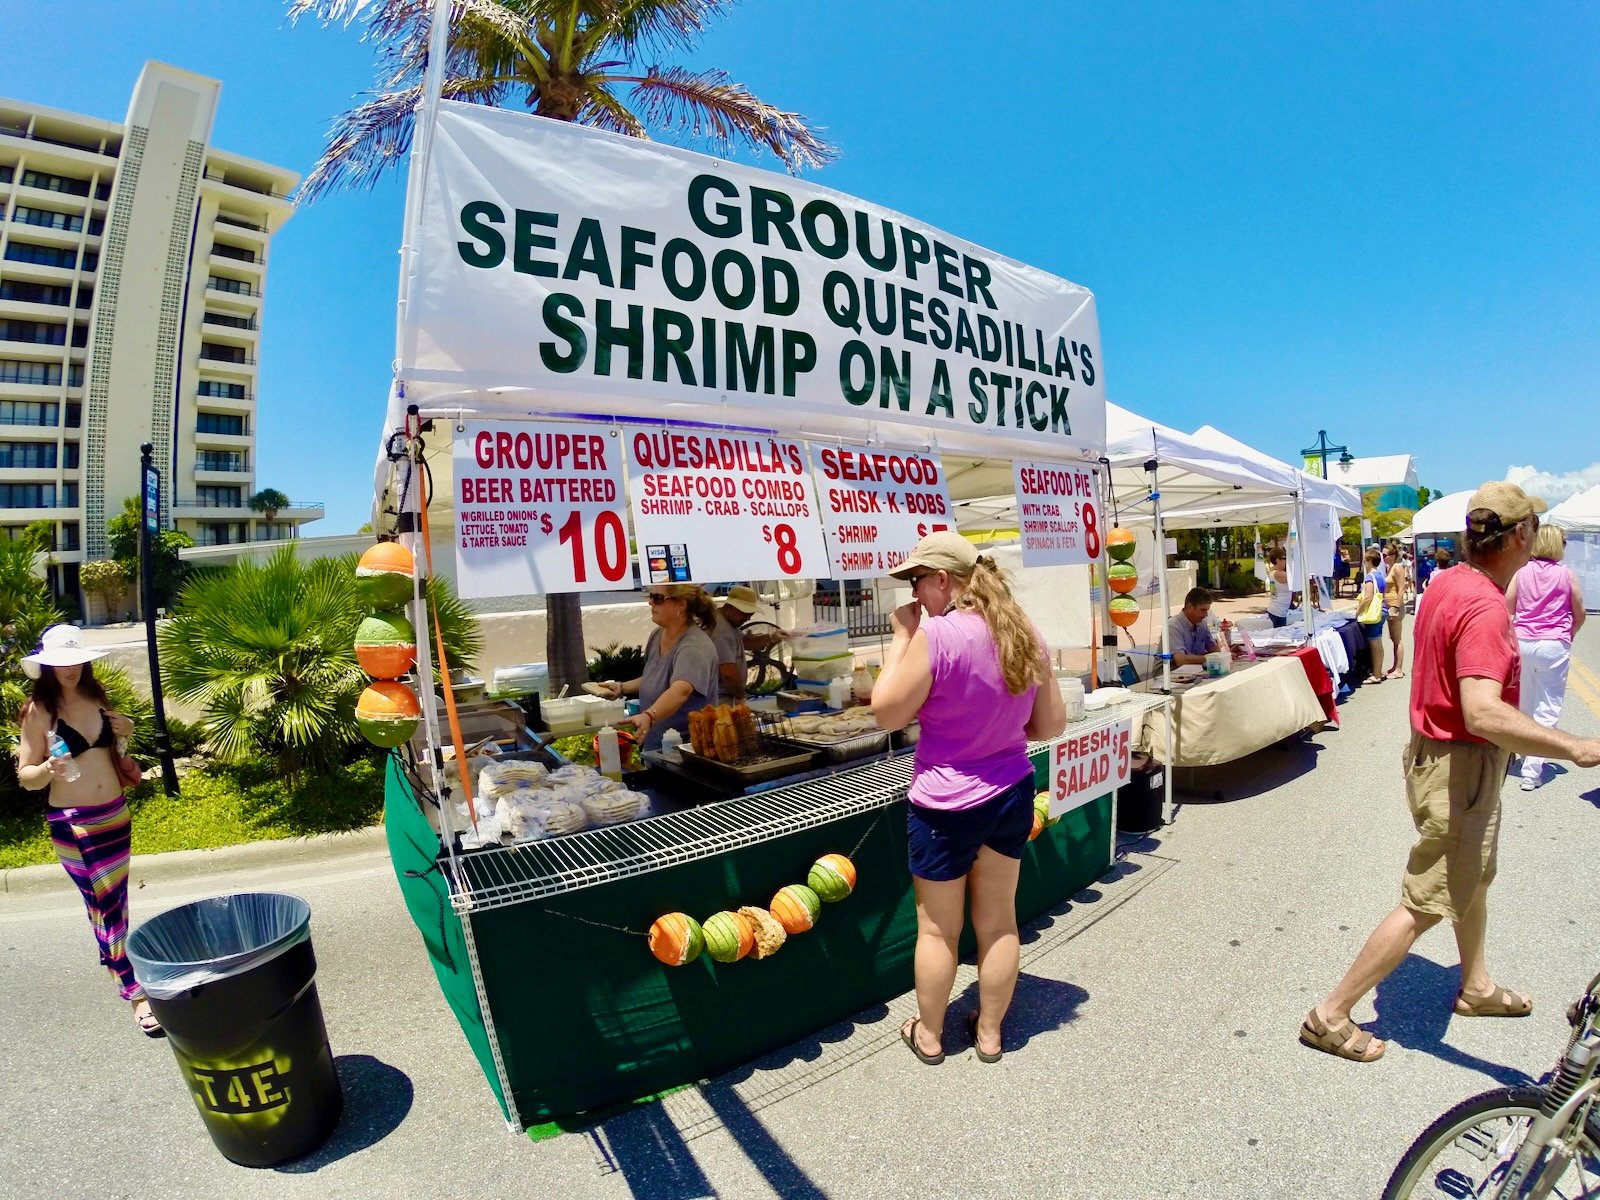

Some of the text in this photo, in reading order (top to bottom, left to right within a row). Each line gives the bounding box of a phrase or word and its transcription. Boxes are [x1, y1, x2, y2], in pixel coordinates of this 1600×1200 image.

[687, 174, 998, 309] GROUPER
[457, 200, 1094, 387] SEAFOOD QUESADILLA'S
[539, 292, 1072, 436] SHRIMP ON A STICK
[475, 430, 608, 471] GROUPER
[633, 432, 803, 476] QUESADILLA'S
[821, 448, 938, 485] SEAFOOD
[461, 478, 616, 504] BEER BATTERED
[643, 474, 805, 501] SEAFOOD COMBO
[1020, 467, 1092, 498] SEAFOOD PIE
[507, 510, 538, 521] ONIONS
[641, 499, 693, 516] SHRIMP
[705, 500, 740, 516] CRAB
[751, 502, 810, 518] SCALLOPS
[1022, 504, 1040, 516] WITH
[461, 523, 529, 536] LETTUCE, TOMATO
[1050, 521, 1078, 533] SCALLOPS
[462, 536, 527, 548] & TARTER SAUCE
[1026, 537, 1077, 550] SPINACH & FETA
[878, 552, 884, 569] &
[1056, 728, 1110, 765] FRESH
[1056, 753, 1109, 801] SALAD
